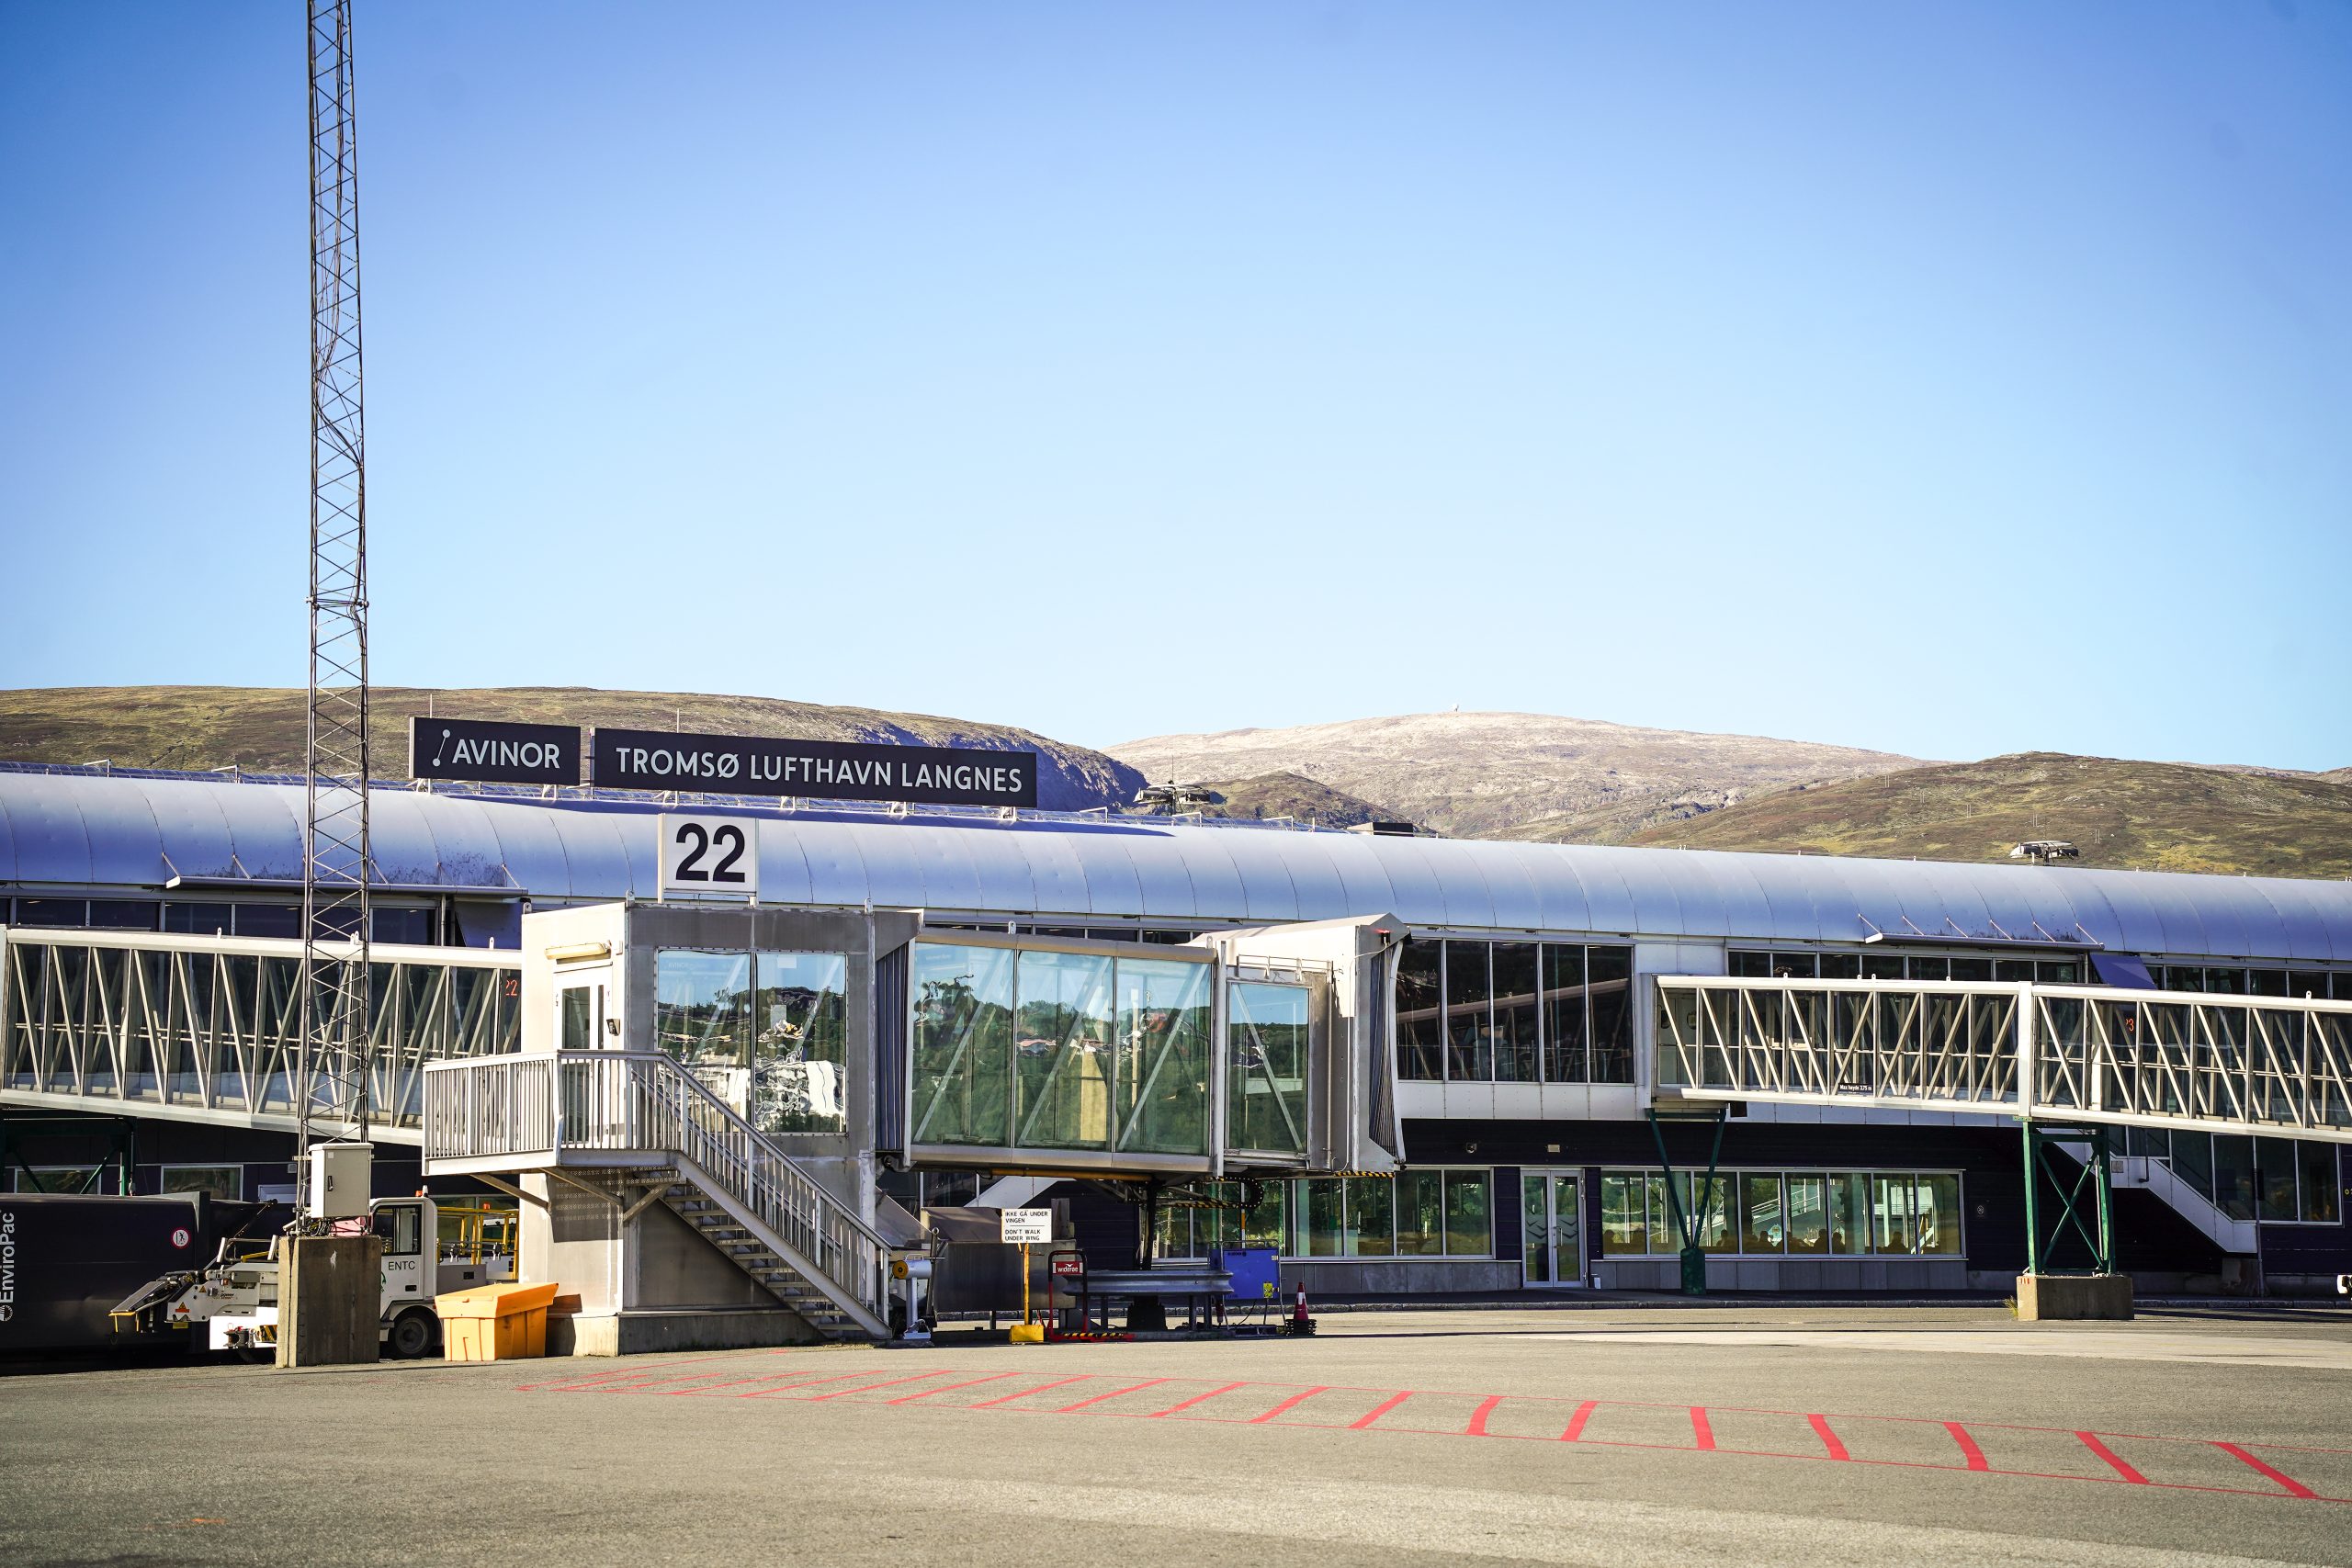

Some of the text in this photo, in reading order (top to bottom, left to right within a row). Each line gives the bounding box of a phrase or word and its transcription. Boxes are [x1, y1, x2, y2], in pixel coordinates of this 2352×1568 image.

[452, 739, 560, 769] AVINOR
[616, 747, 1023, 793] TROMSØ LUFTHAVN LANGNES
[675, 823, 745, 883] 22
[0, 1213, 15, 1303] EnviroPac
[388, 1260, 415, 1270] ENTC
